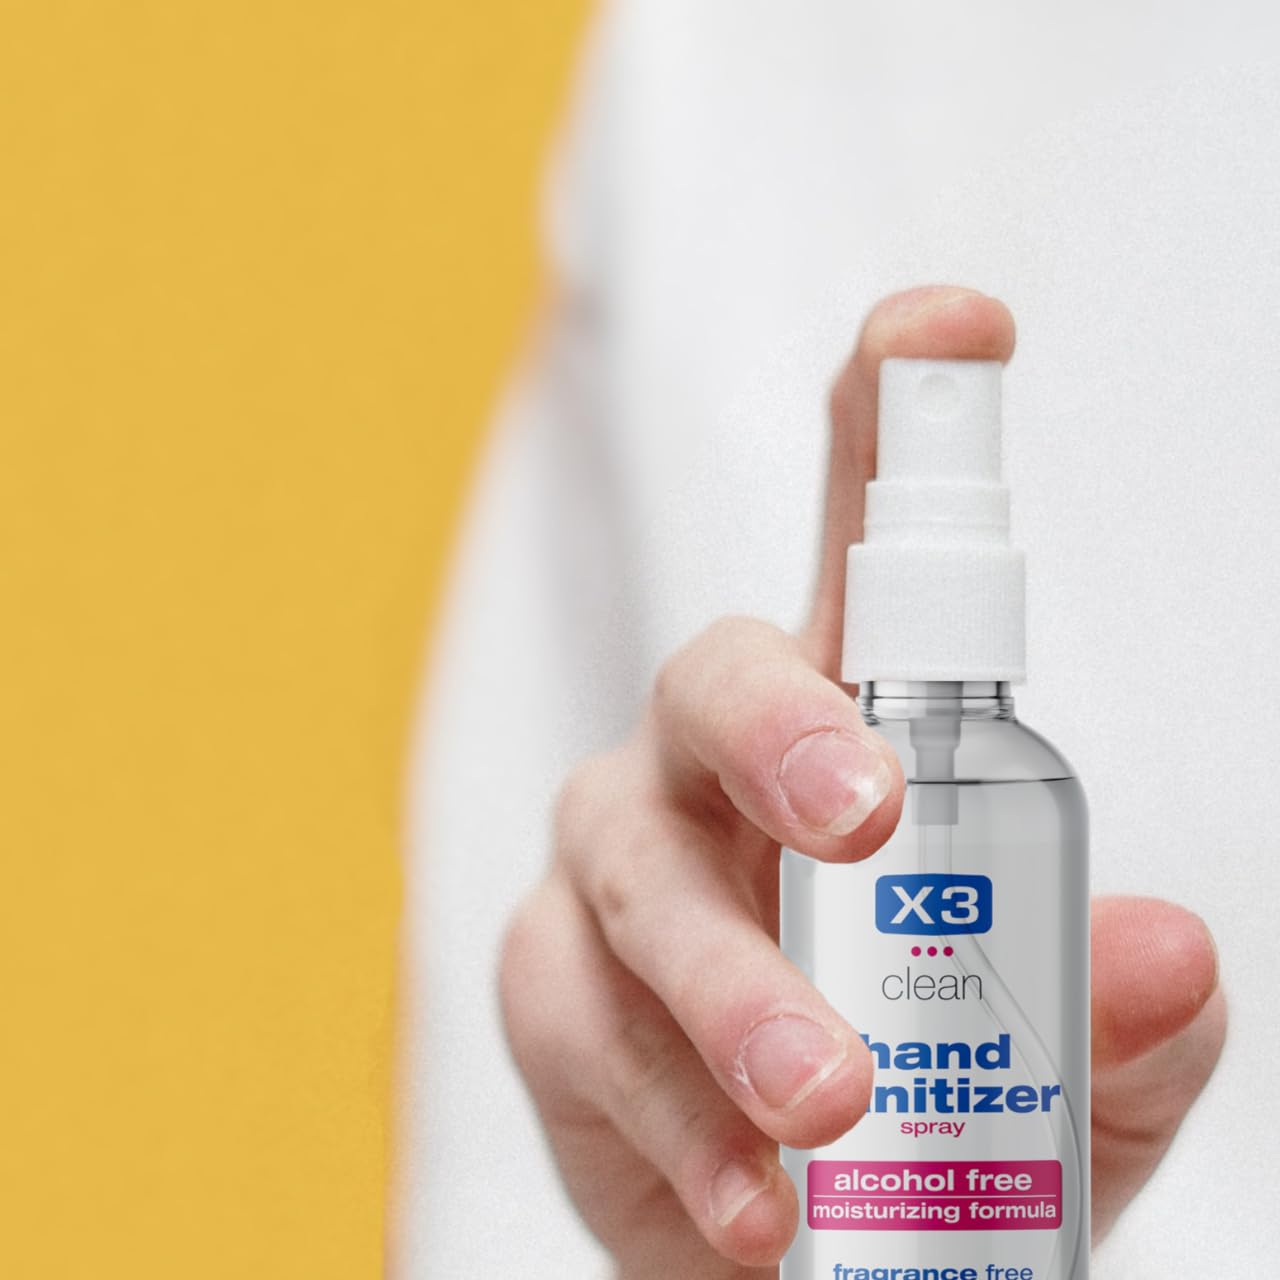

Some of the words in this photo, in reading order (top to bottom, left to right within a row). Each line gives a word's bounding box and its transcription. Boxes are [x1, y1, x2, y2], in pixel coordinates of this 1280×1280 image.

[889, 885, 980, 925] X3
[881, 965, 983, 1001] clean
[866, 1077, 1061, 1114] nitizer
[900, 1121, 966, 1138] spray
[833, 1168, 955, 1192] alcohol
[965, 1168, 1033, 1192] free
[812, 1201, 961, 1224] moisturizing
[968, 1201, 1057, 1220] formula
